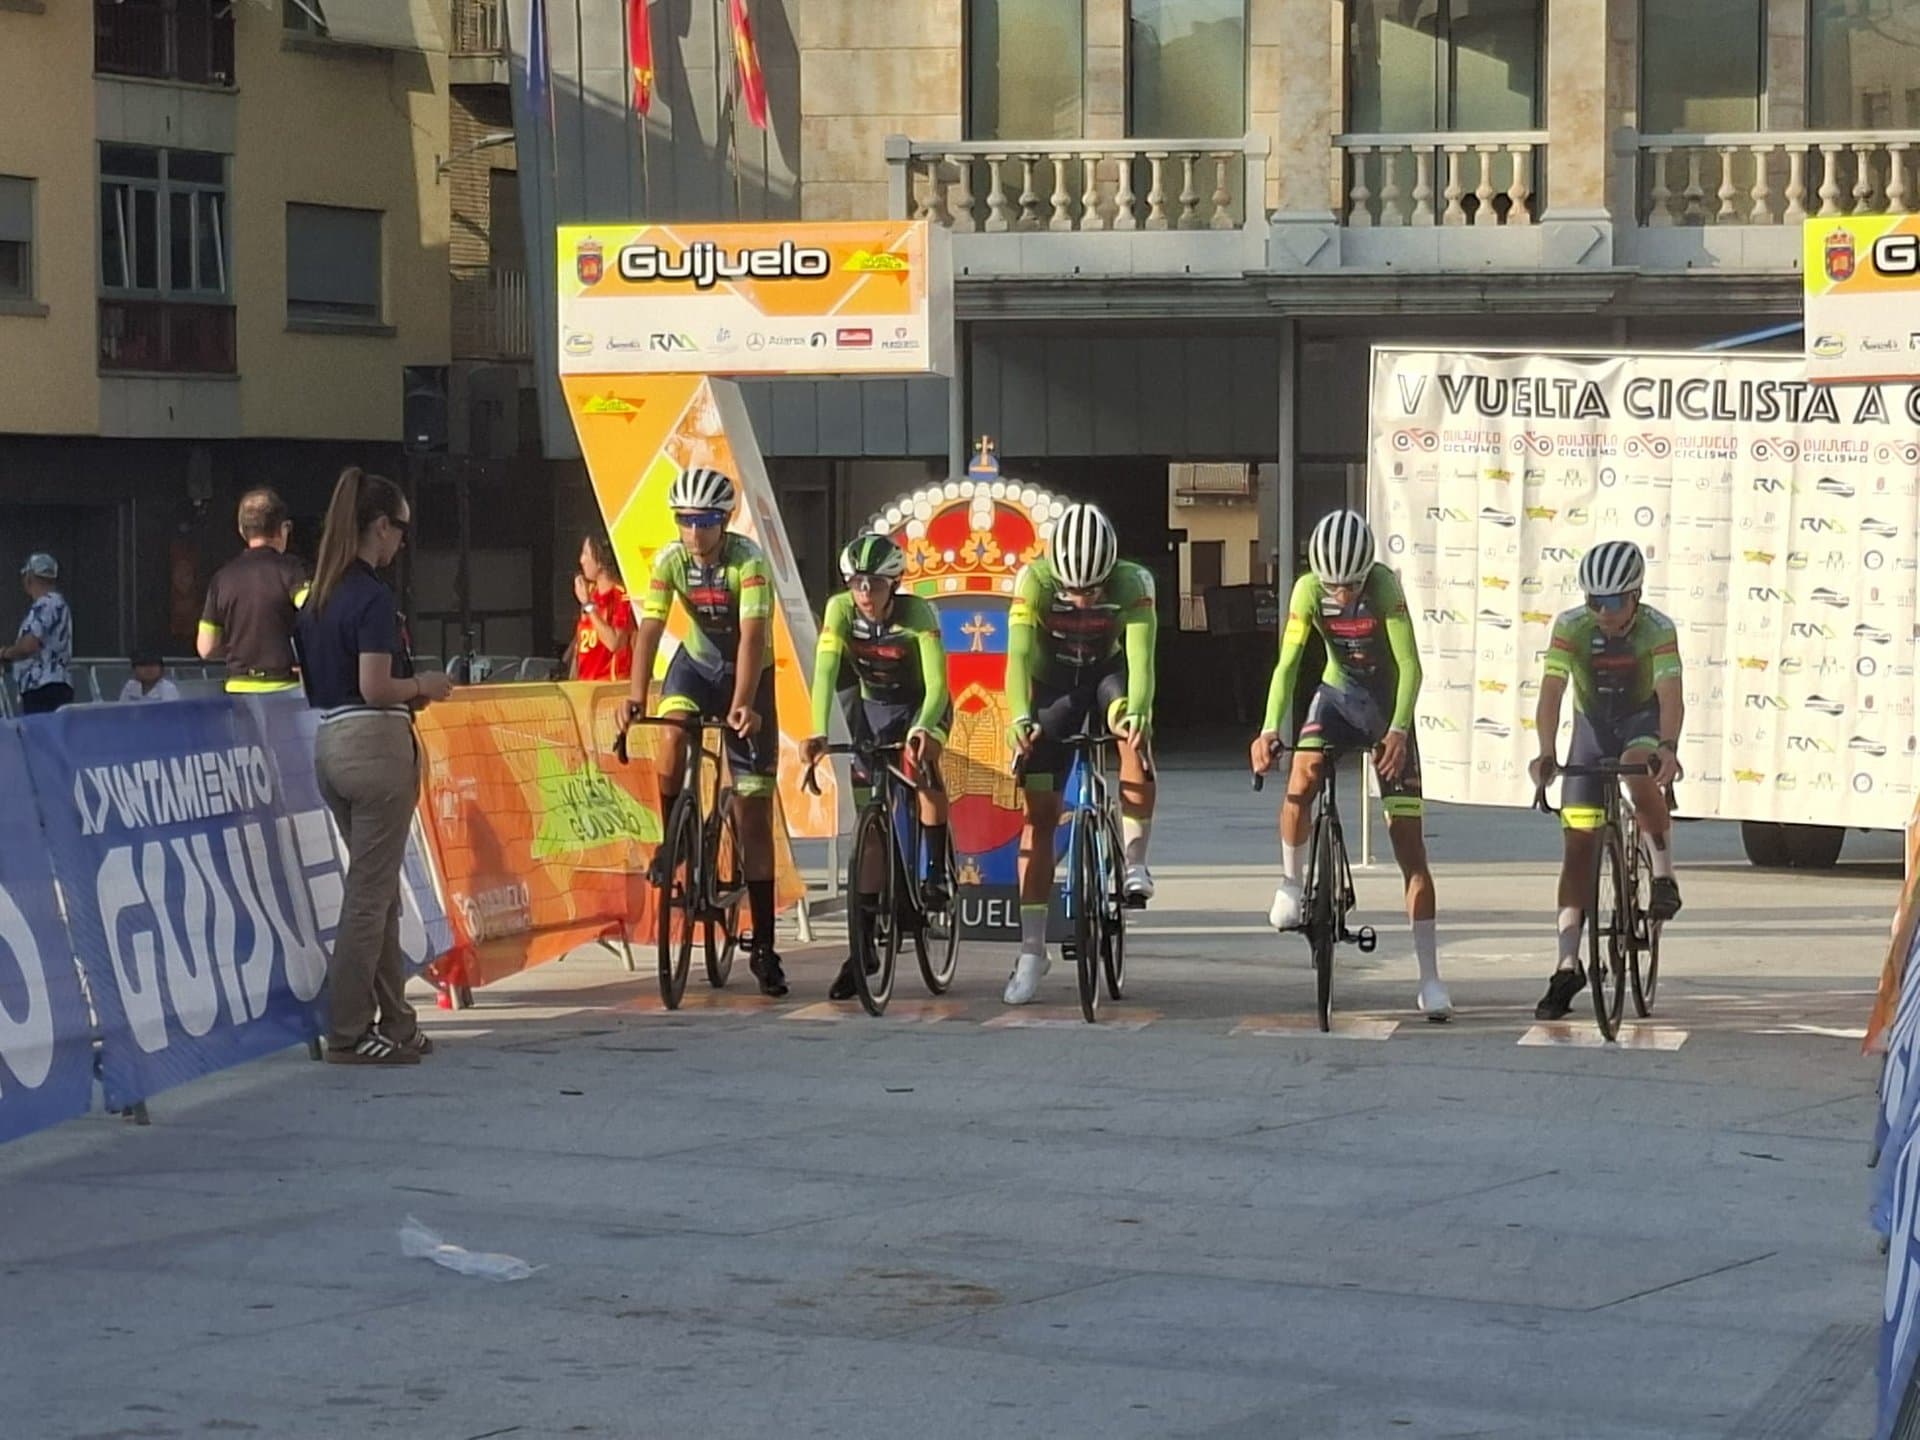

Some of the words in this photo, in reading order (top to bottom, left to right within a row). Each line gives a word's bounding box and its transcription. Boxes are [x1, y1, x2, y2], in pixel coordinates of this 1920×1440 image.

[619, 242, 830, 288] Guijuelo
[1397, 374, 1427, 415] V
[1438, 375, 1611, 419] VUELTA
[1623, 378, 1840, 424] CICLISTA
[1853, 384, 1890, 425] A
[74, 744, 273, 835] AYUNTAMIENTO
[97, 808, 429, 1054] GUIJUE
